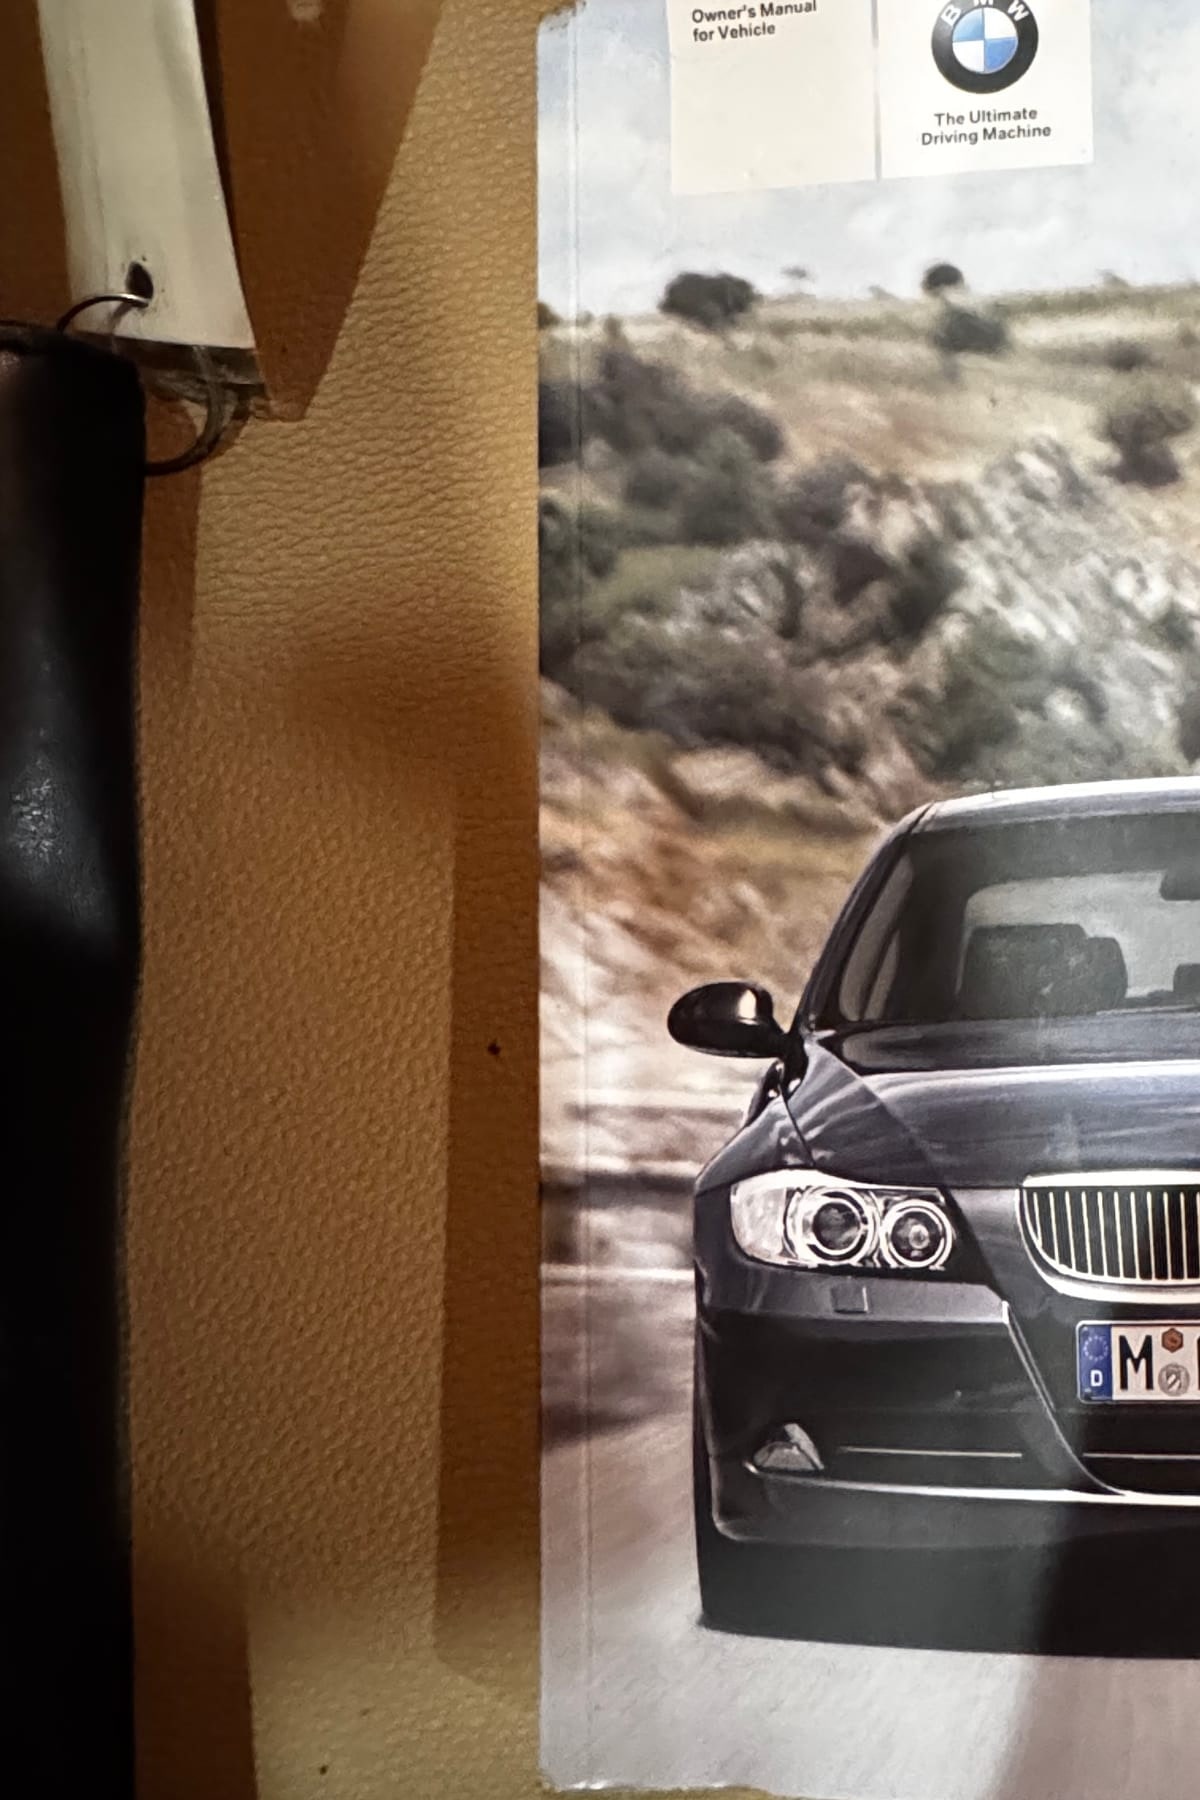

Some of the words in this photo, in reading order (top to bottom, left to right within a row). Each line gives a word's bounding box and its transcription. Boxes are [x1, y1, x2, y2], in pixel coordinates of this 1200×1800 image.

[692, 4, 757, 24] Owner's
[760, 0, 817, 17] Manual
[693, 27, 715, 42] for
[717, 21, 776, 40] Vehicle
[933, 111, 965, 127] The
[969, 107, 1038, 124] Ultimate
[921, 129, 979, 146] Driving
[982, 124, 1052, 141] Machine
[1118, 1334, 1155, 1391] M
[1090, 1369, 1104, 1387] D
